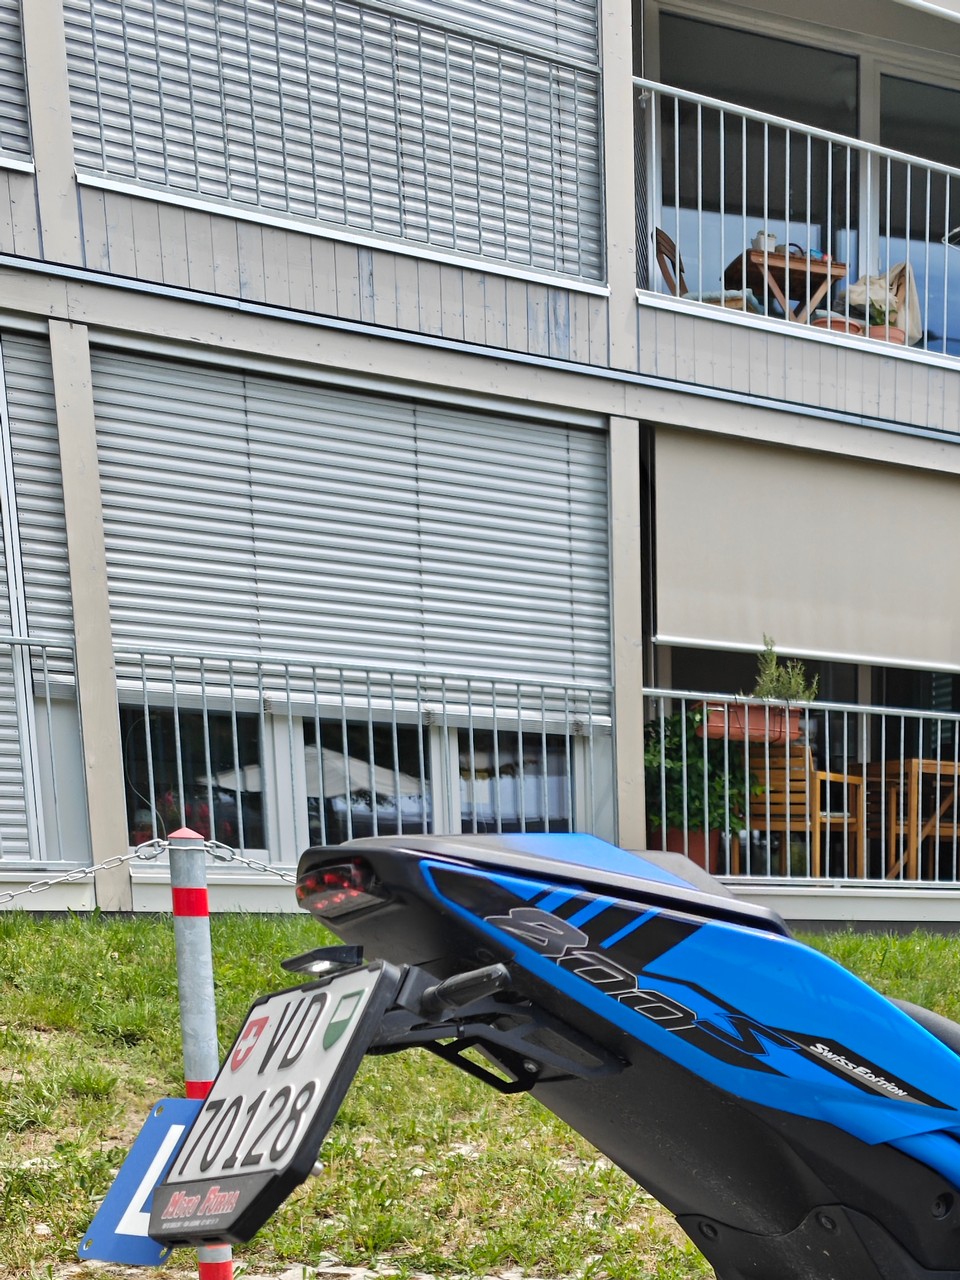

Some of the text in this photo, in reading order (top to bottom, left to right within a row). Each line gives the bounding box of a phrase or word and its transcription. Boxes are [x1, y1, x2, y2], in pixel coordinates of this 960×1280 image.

[257, 991, 332, 1076] VD
[178, 1078, 321, 1176] 70128
[114, 1124, 186, 1237] L
